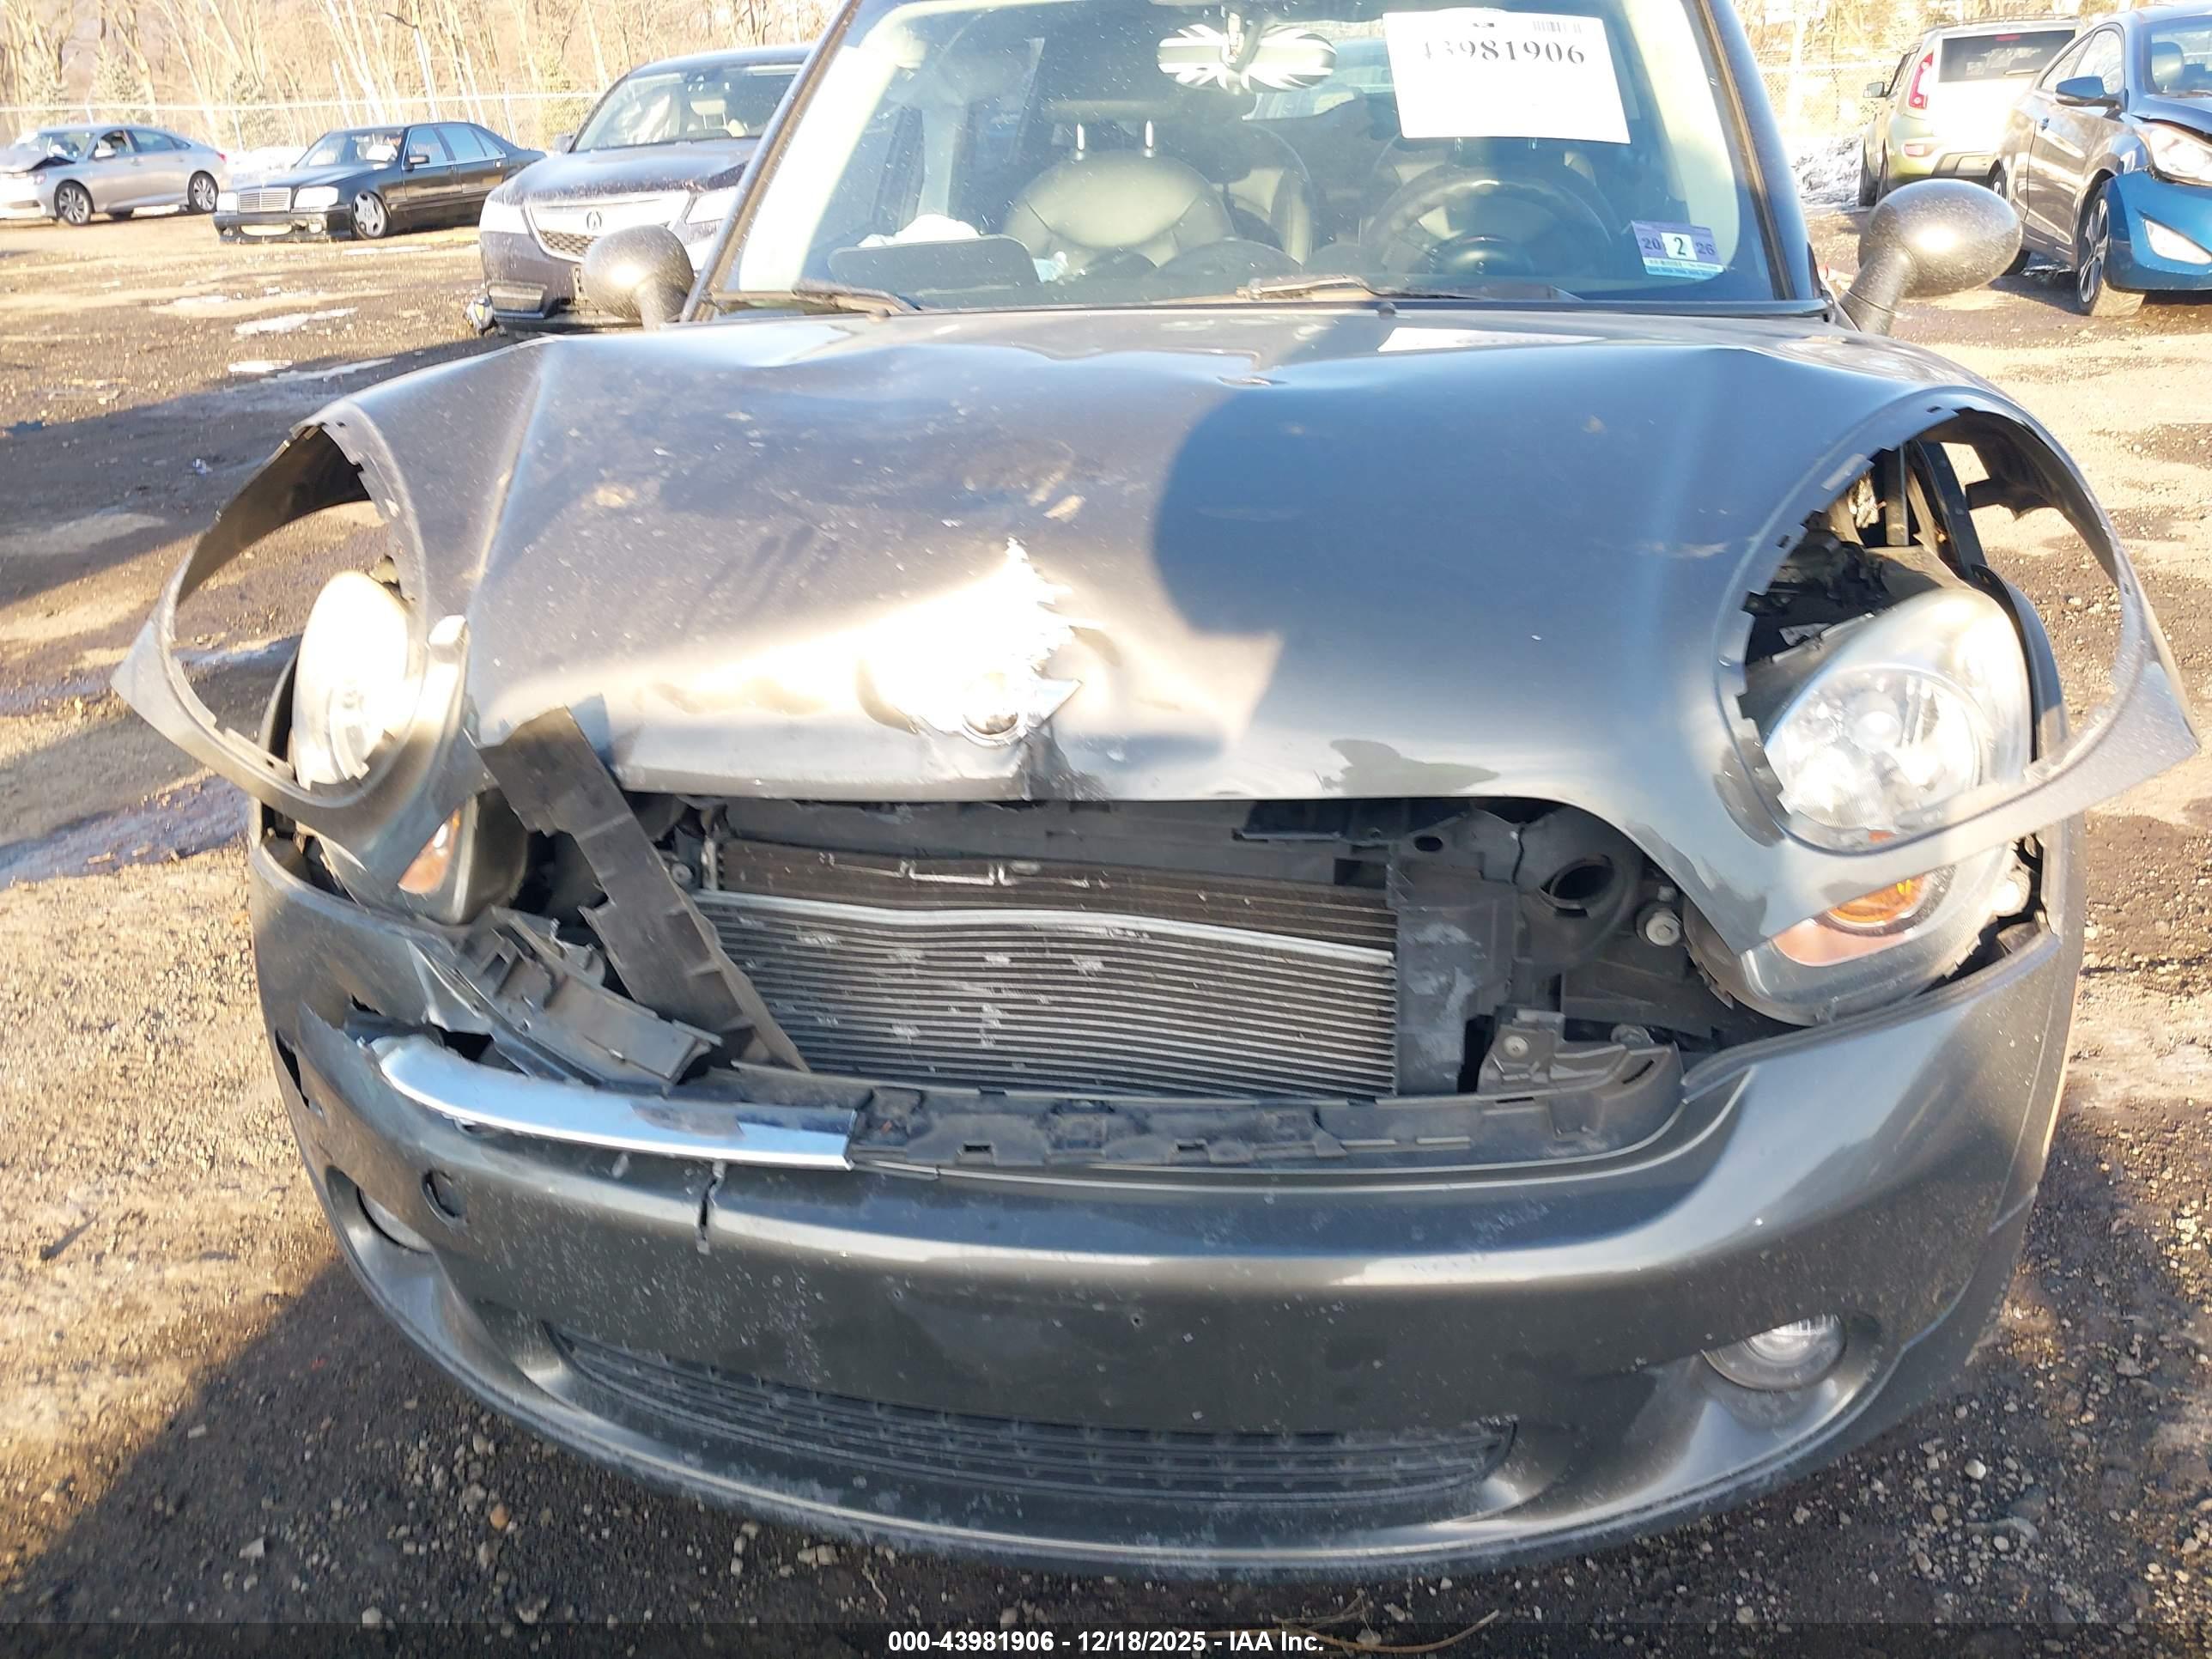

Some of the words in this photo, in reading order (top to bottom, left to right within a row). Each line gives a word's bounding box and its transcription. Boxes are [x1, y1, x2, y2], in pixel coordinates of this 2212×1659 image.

[1641, 236, 1662, 251] 20
[1673, 236, 1687, 256] 2
[1695, 241, 1717, 256] 26
